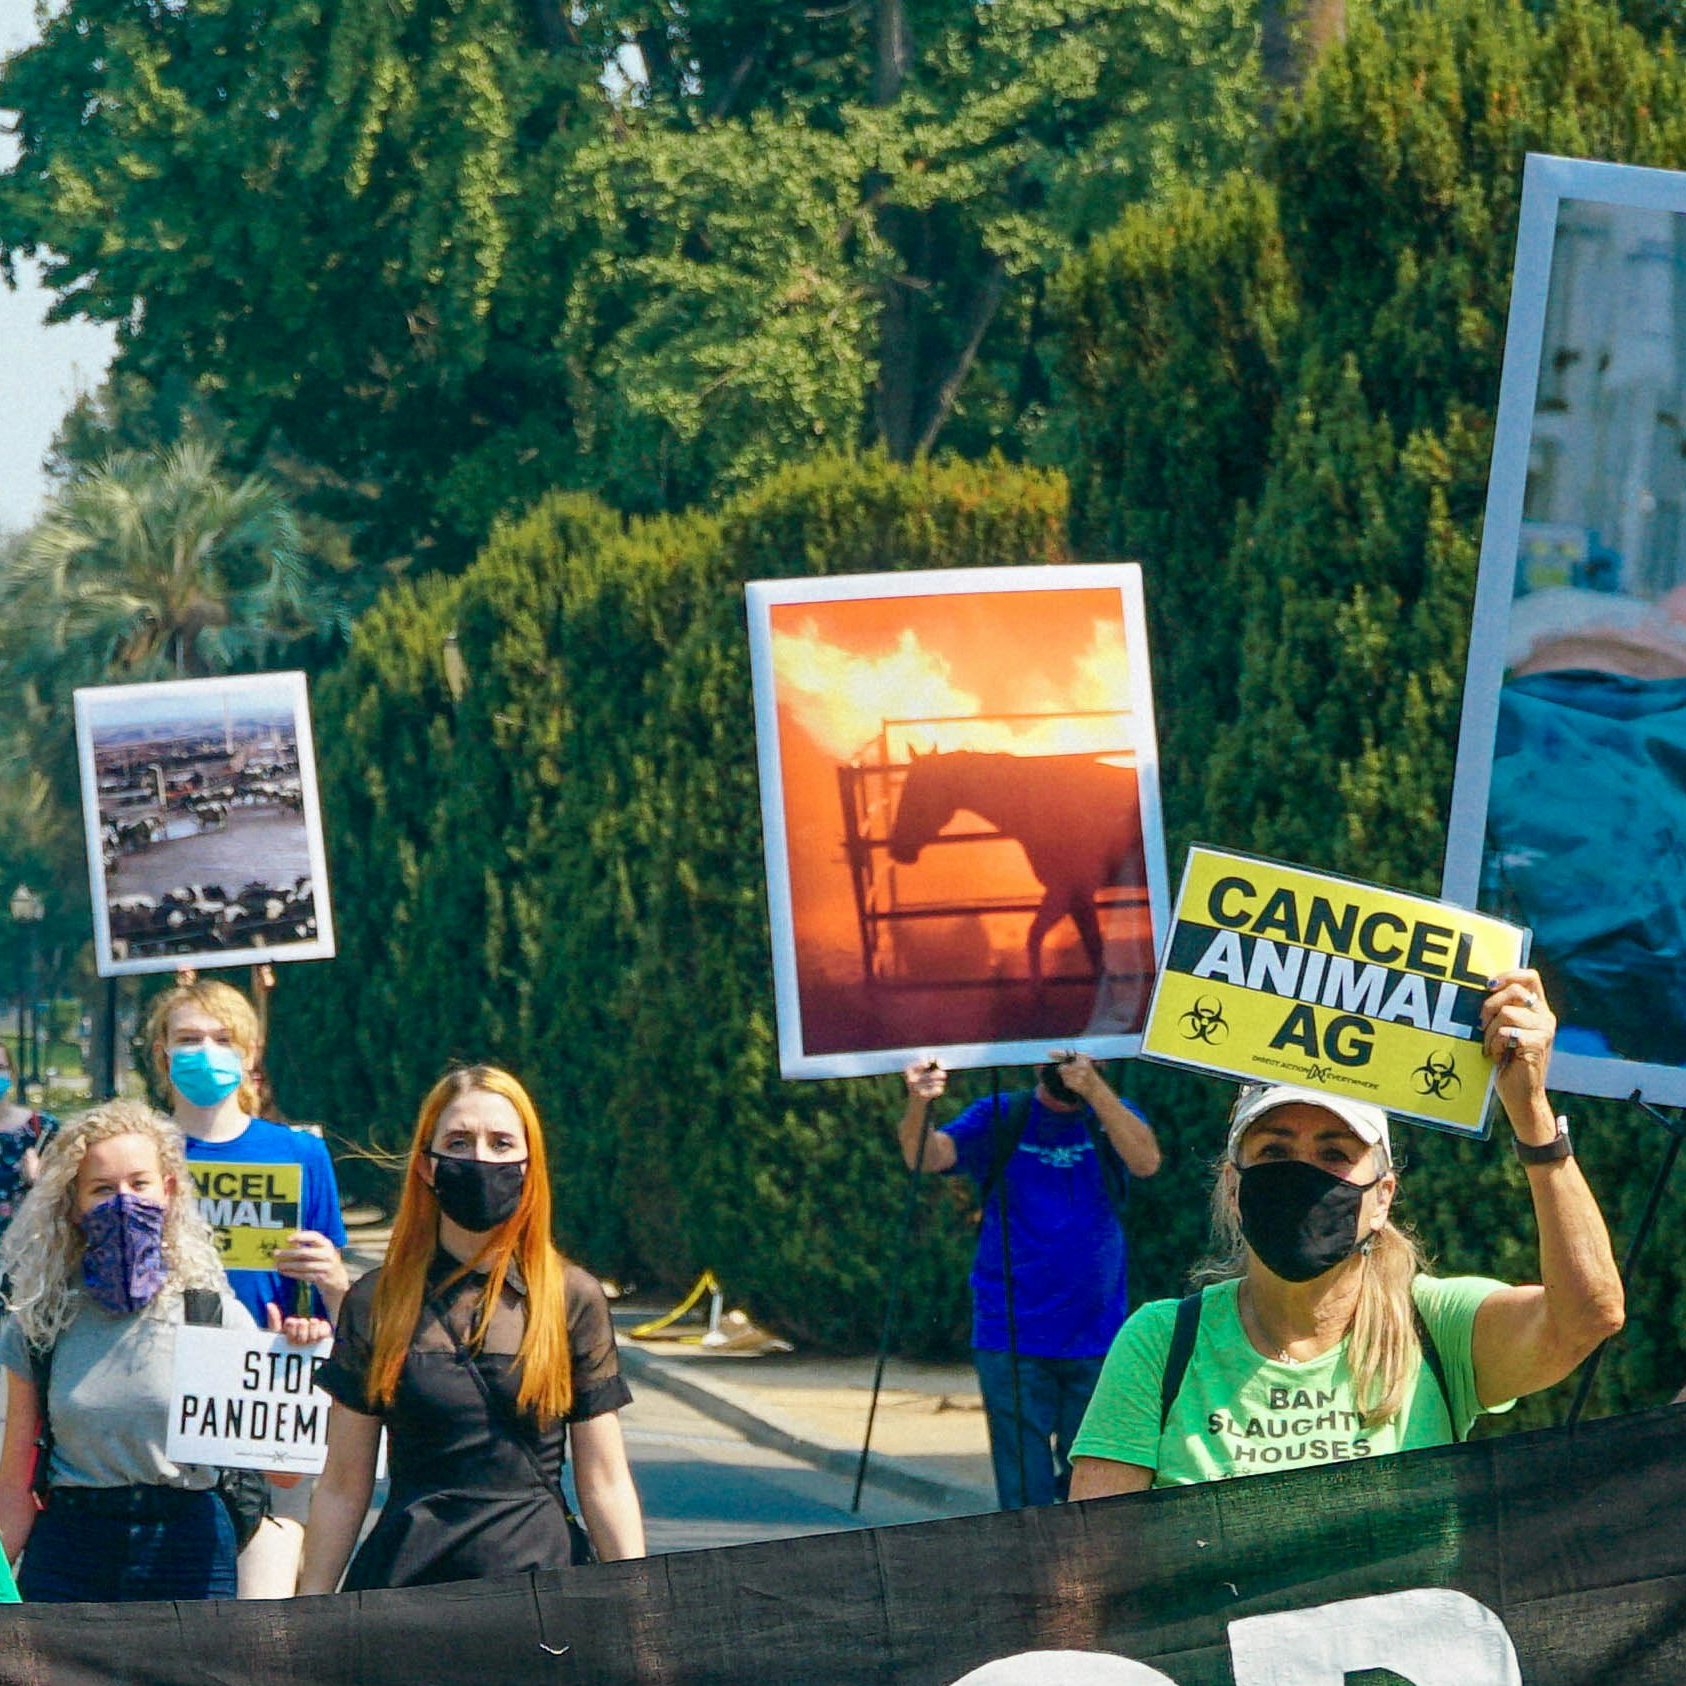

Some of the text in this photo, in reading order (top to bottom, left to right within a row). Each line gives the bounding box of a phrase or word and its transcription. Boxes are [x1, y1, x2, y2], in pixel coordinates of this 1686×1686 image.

[1207, 876, 1490, 985] CANCEL
[1193, 929, 1474, 1040] ANIMAL
[1268, 1004, 1376, 1067] AG
[189, 1171, 286, 1199] NCEL
[1270, 1387, 1337, 1410] BAN
[180, 1395, 331, 1446] PANDEMI
[1208, 1410, 1375, 1439] SLAUGHT
[1234, 1438, 1372, 1464] HOUSES
